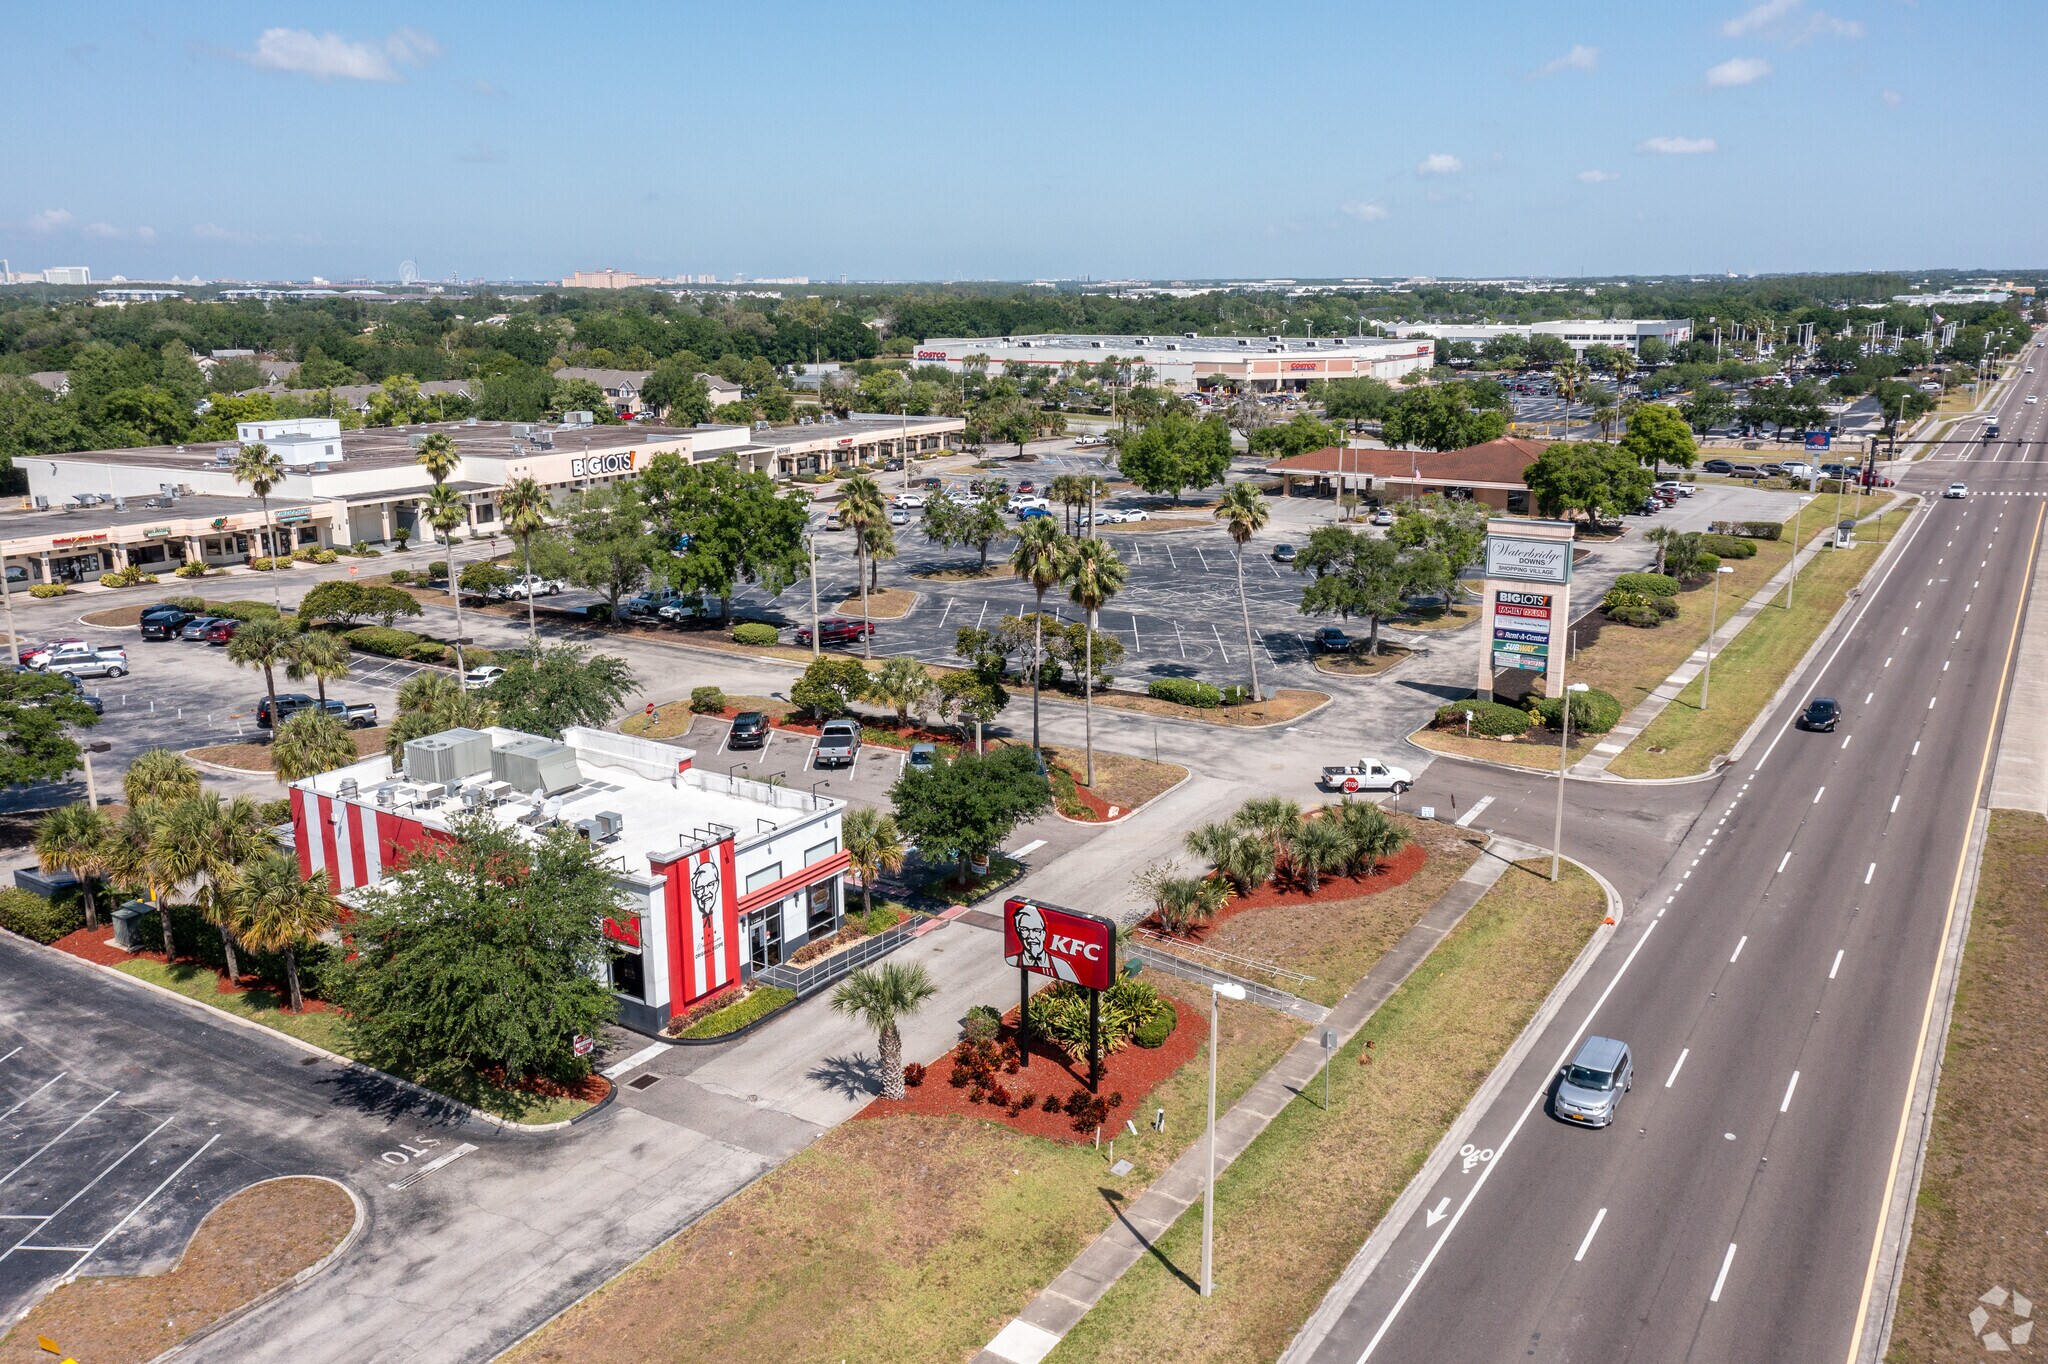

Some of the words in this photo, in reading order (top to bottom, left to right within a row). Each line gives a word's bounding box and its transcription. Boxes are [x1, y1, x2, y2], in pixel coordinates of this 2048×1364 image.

[1492, 542, 1562, 565] Waterbridge
[1519, 557, 1546, 566] DOWNS
[1498, 565, 1528, 573] SHOPPING
[1529, 567, 1554, 576] VILLAGE
[1499, 605, 1523, 615] FAMILY
[1503, 643, 1538, 653] SUBWAY
[1049, 934, 1100, 961] KFC
[372, 1134, 442, 1168] STO
